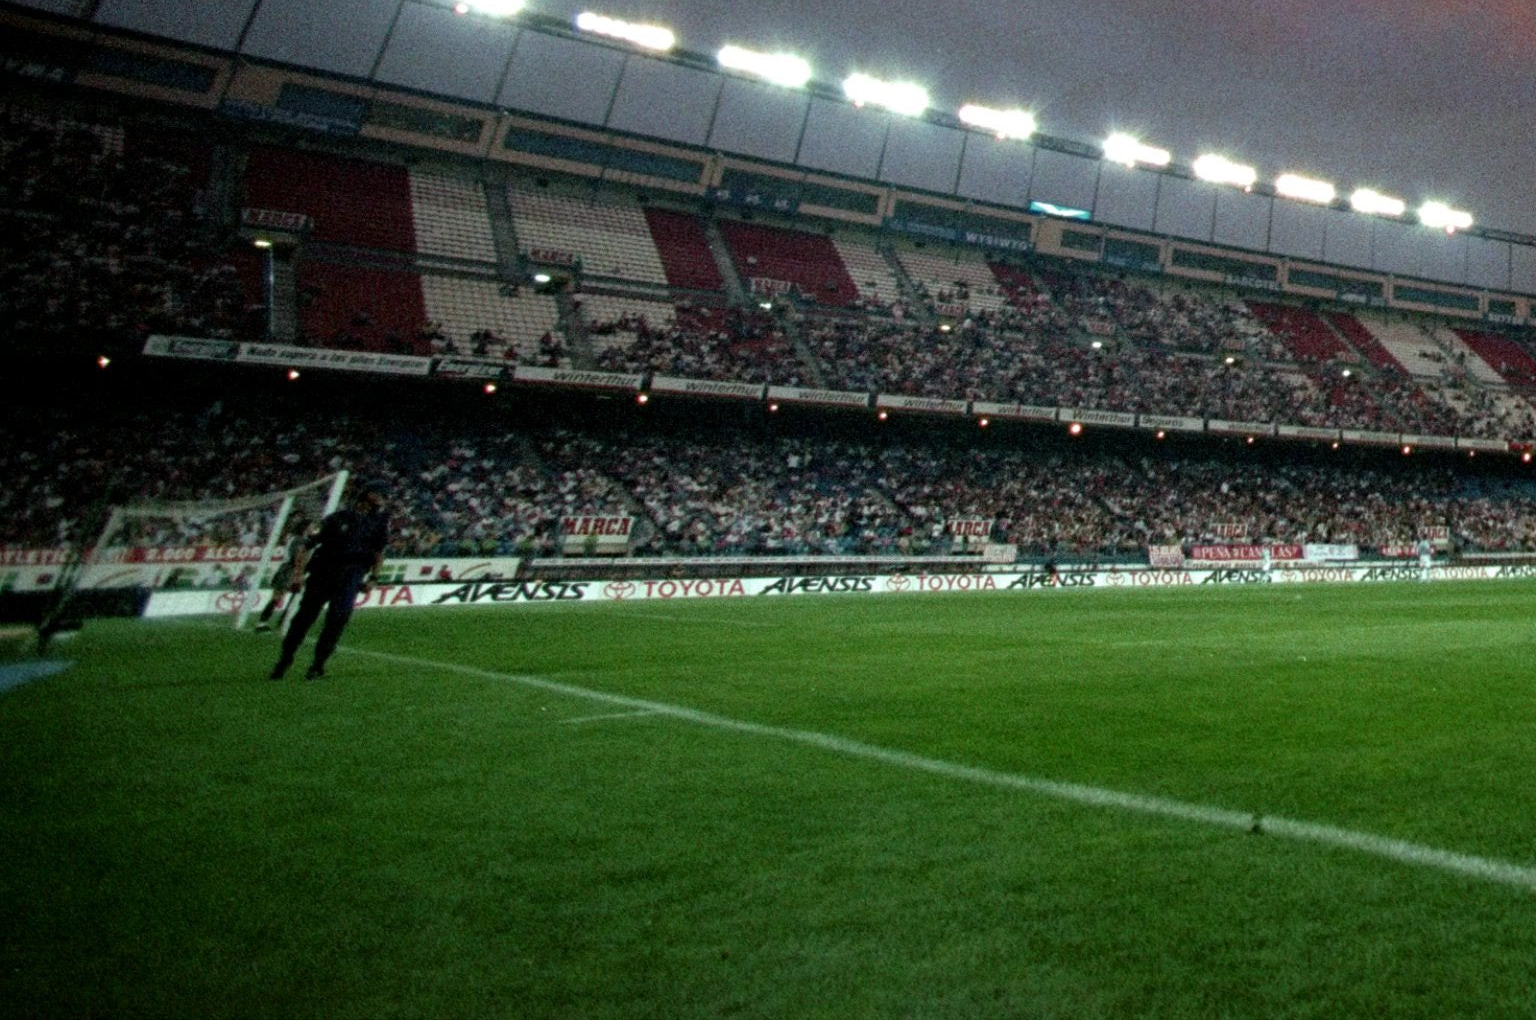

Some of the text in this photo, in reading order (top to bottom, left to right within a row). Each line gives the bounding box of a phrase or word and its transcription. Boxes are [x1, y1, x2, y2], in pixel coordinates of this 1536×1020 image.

[554, 371, 637, 385] winterthur
[686, 381, 760, 393] winterthur
[563, 517, 632, 535] MARCA
[1130, 570, 1192, 586] TOYOTA
[1301, 568, 1354, 581] TOYOTA
[1442, 566, 1488, 579] TOYOTA
[643, 579, 746, 598] TOYOTA
[757, 577, 876, 595] AVENSIS
[916, 573, 996, 591] TOYOTA
[431, 582, 592, 604] AVENSIS
